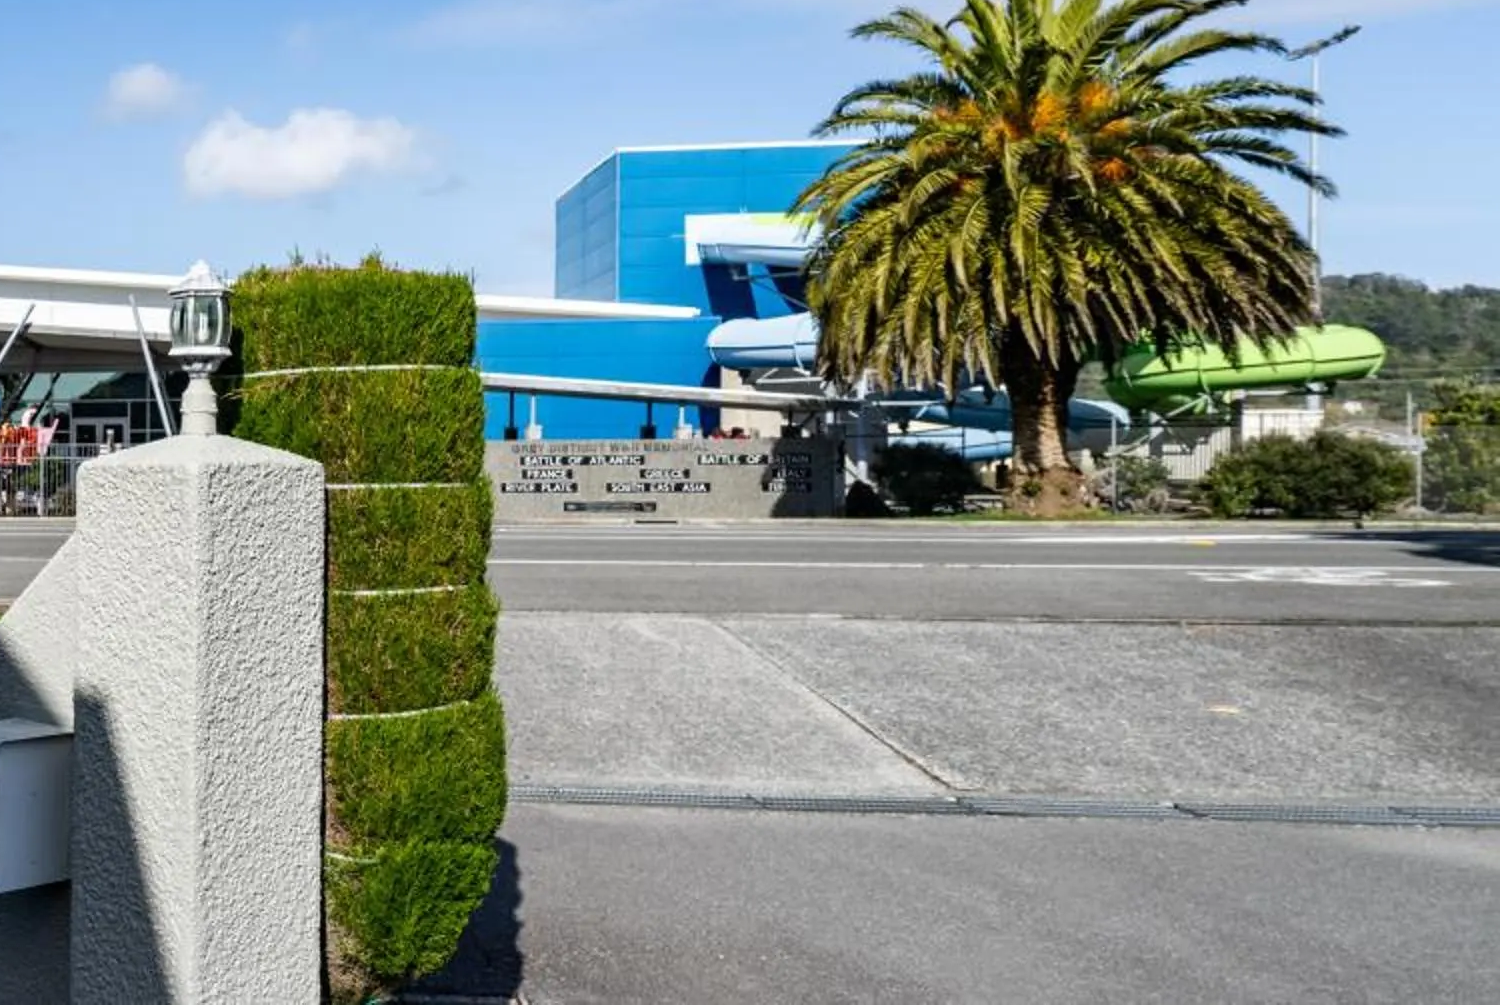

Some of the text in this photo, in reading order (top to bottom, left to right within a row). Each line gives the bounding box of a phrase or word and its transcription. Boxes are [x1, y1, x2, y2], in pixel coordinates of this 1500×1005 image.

[523, 455, 642, 466] BATTLE OF ATLANTIC
[700, 454, 739, 465] BATTLE
[527, 469, 567, 479] FRANCE
[682, 482, 708, 493] ASIA
